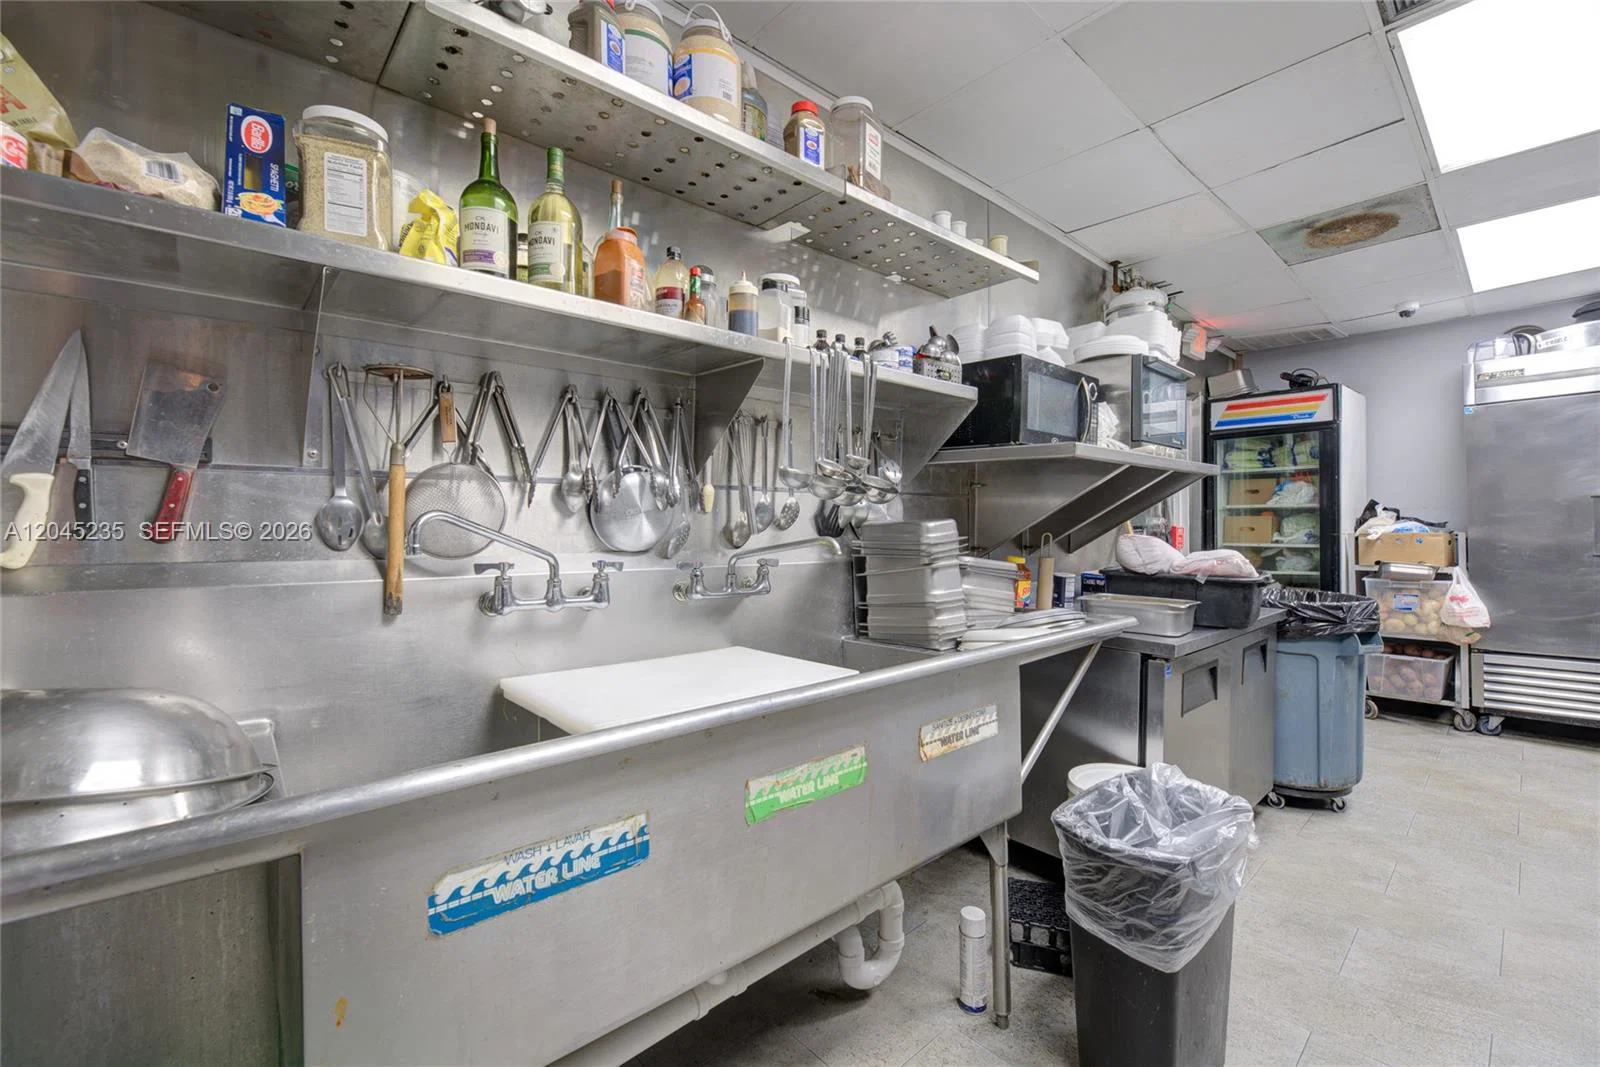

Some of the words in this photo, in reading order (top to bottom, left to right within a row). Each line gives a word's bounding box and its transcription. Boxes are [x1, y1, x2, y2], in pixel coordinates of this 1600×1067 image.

[251, 122, 265, 151] Barilla
[270, 163, 279, 193] SPAGHETTI
[464, 221, 500, 235] MONDAVI
[940, 730, 965, 747] WATER
[965, 725, 980, 740] LINE
[779, 780, 816, 804] WATER
[817, 774, 840, 790] LINE
[503, 846, 543, 866] WASH
[555, 828, 592, 851] LAVAR
[491, 866, 559, 904] WATER
[561, 853, 601, 881] LINE
